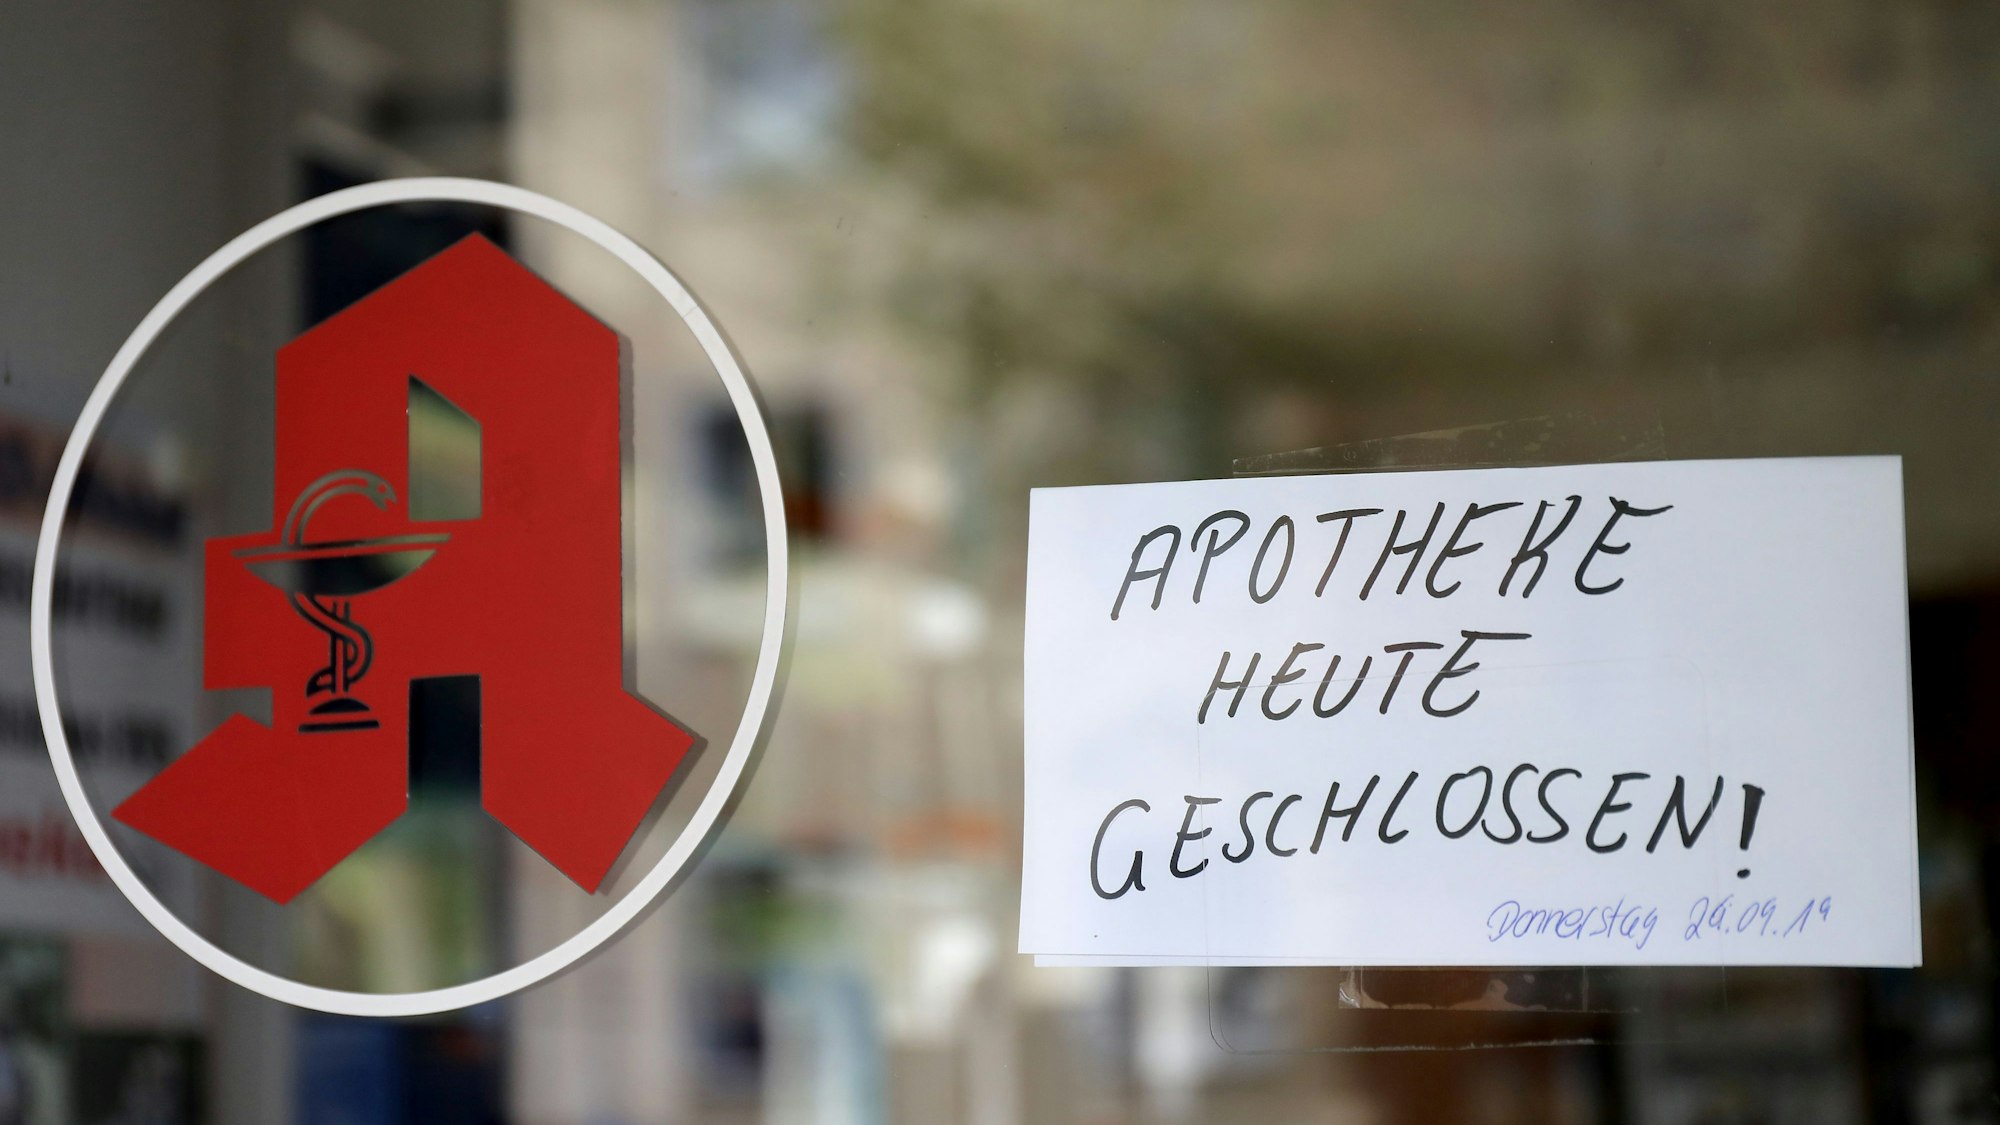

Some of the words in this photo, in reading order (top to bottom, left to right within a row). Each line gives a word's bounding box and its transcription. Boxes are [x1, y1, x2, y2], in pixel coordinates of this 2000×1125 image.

[1110, 494, 1674, 621] APOTHEKE
[1198, 629, 1532, 725] HEUTE
[1090, 763, 1766, 900] GESCHLOSSEN!
[1487, 896, 1658, 950] Donnerstag
